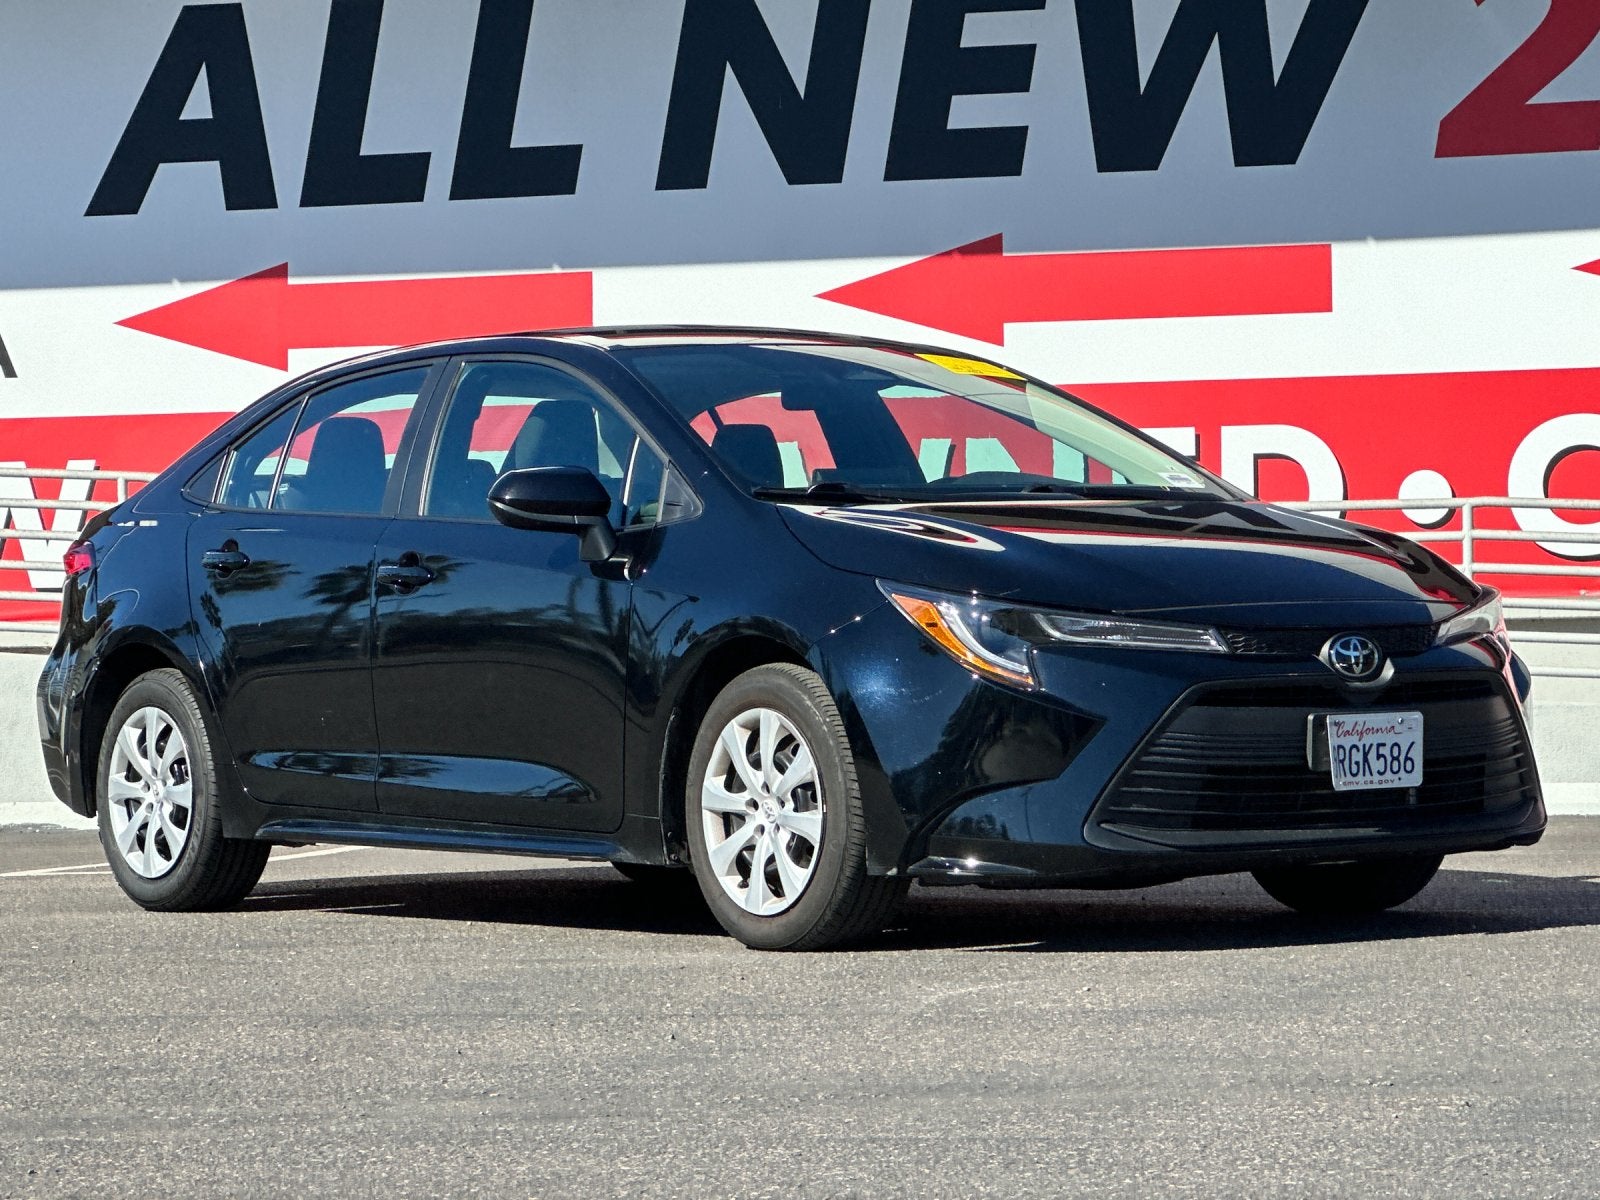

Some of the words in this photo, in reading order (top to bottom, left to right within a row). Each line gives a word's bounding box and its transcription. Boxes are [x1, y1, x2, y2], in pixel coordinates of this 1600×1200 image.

[83, 0, 583, 217] ALL
[655, 0, 1369, 191] NEW
[1336, 720, 1402, 741] California
